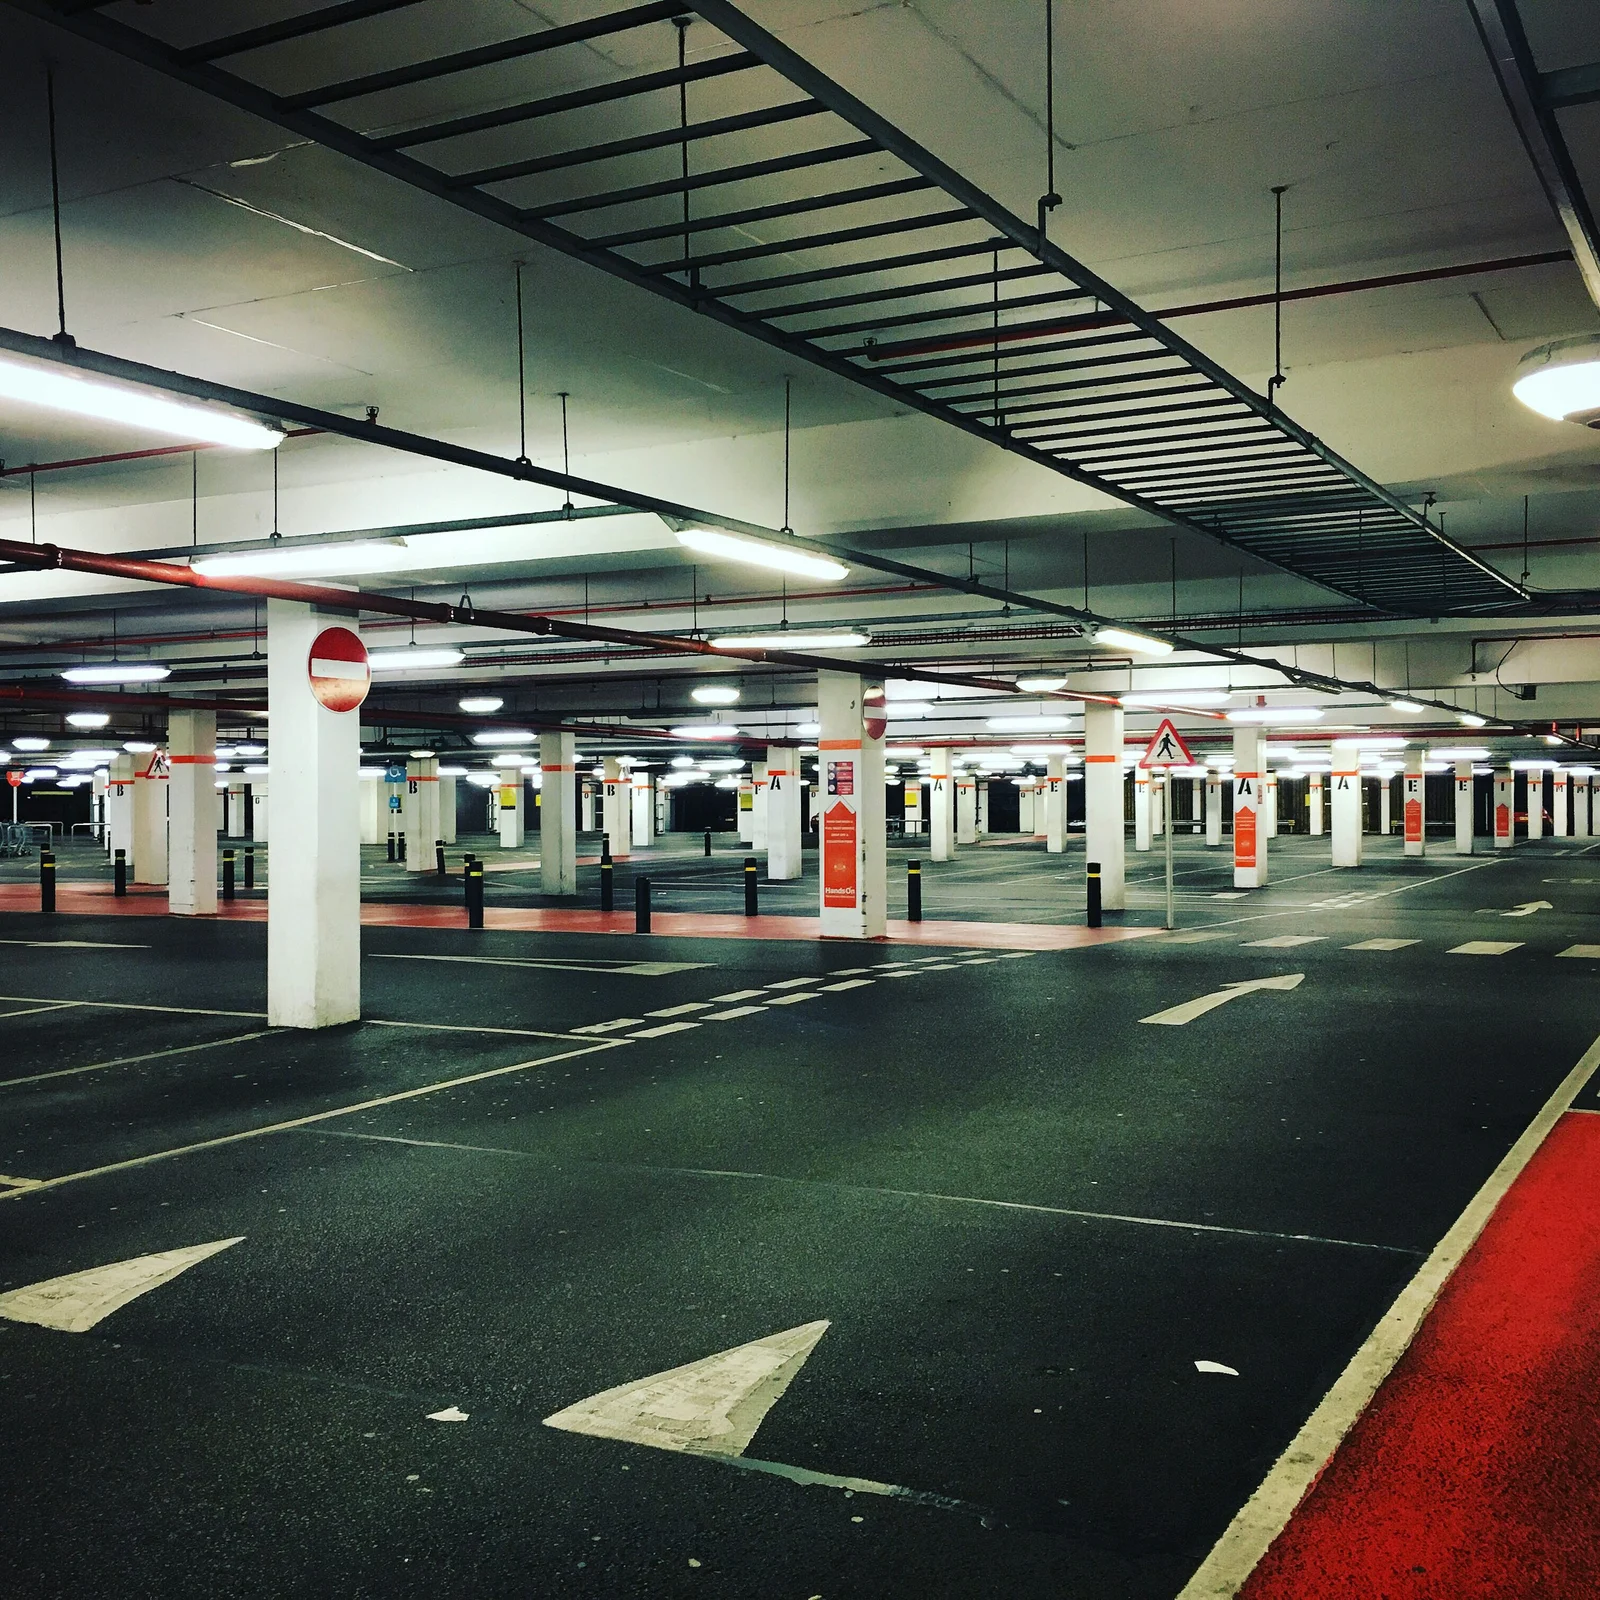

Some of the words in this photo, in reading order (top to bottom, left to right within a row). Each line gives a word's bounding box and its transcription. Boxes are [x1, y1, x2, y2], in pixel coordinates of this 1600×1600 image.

[408, 781, 418, 794] B
[770, 775, 781, 790] A
[934, 778, 943, 791] A
[1050, 781, 1058, 792] E
[1237, 777, 1252, 794] A
[1338, 776, 1349, 790] A
[1408, 780, 1418, 792] E
[1459, 780, 1467, 791] E
[1501, 781, 1505, 791] I
[1532, 783, 1536, 792] I
[117, 784, 124, 796] B
[607, 784, 615, 796] B
[755, 784, 761, 795] F
[961, 786, 966, 795] J
[1036, 787, 1042, 796] J
[1210, 784, 1214, 793] I
